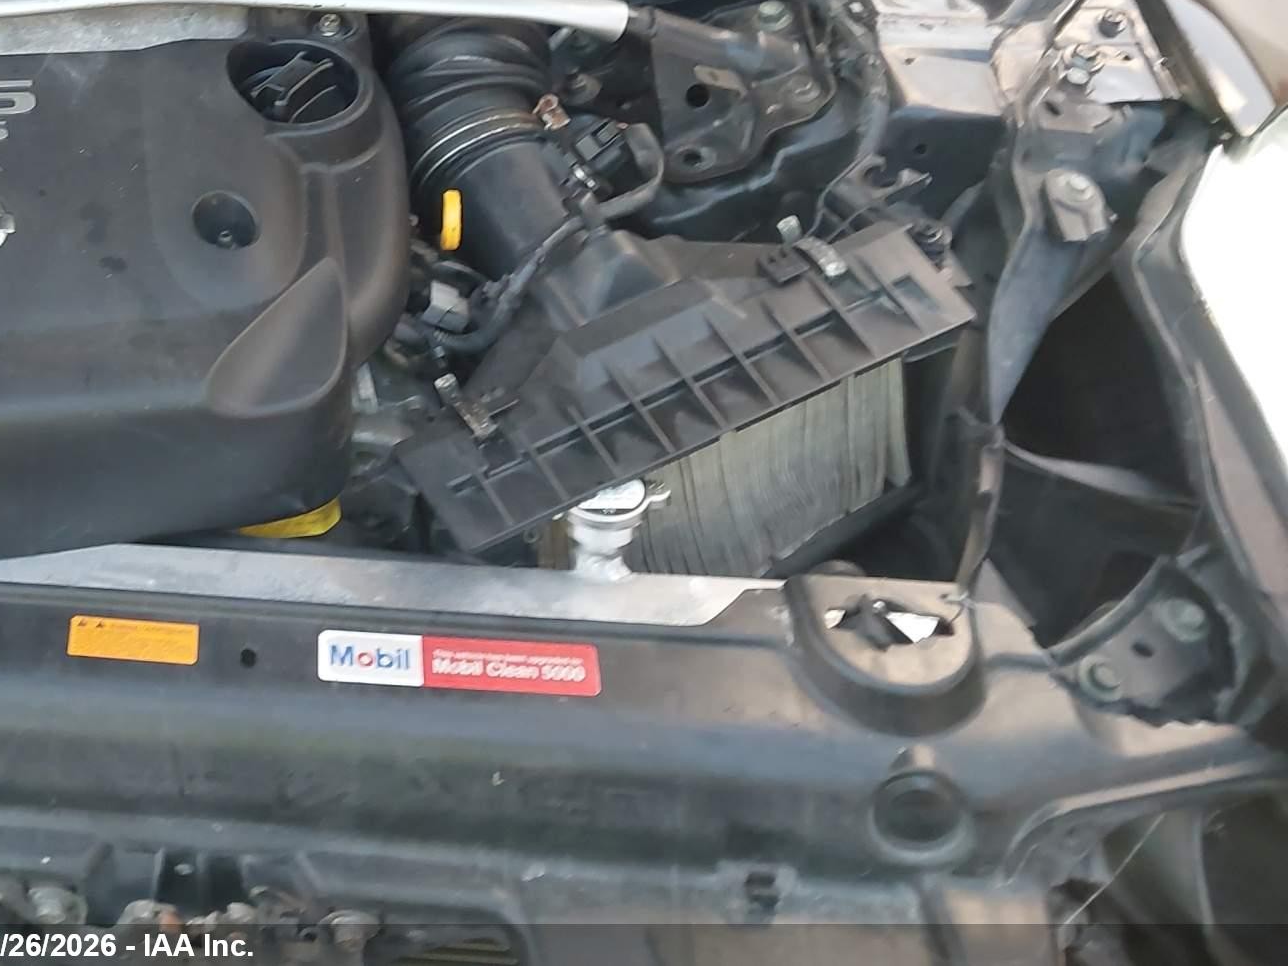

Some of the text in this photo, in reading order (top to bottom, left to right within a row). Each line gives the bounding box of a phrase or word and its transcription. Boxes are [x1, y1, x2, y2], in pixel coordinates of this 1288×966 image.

[329, 644, 411, 670] Mobil
[432, 658, 484, 676] Mobil
[486, 661, 540, 679] Clean
